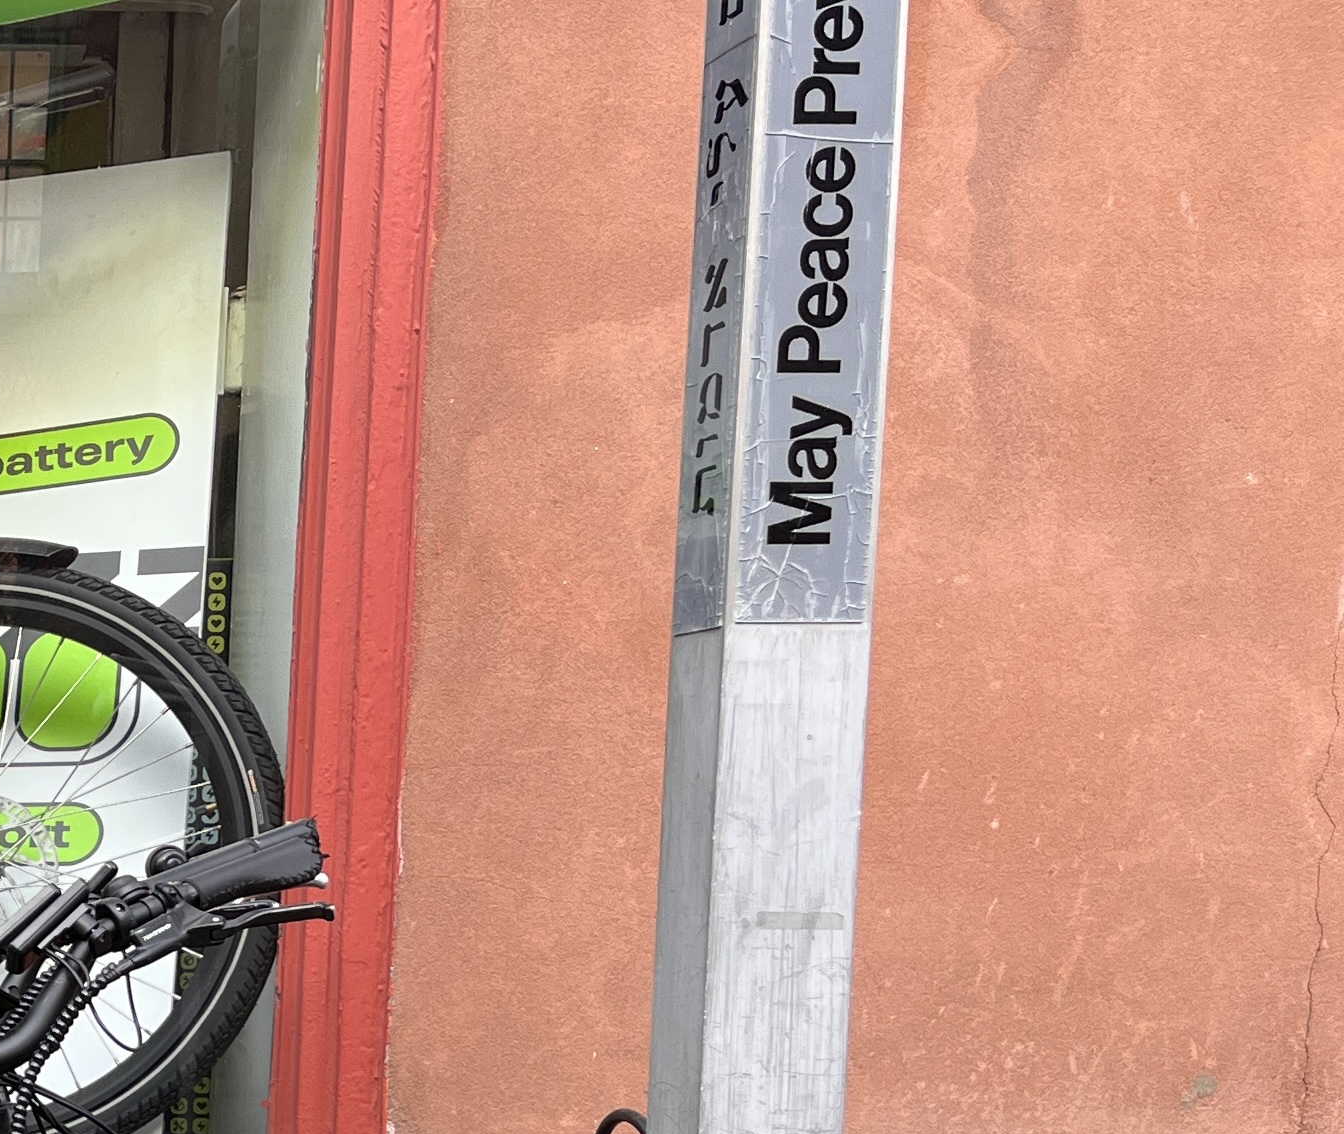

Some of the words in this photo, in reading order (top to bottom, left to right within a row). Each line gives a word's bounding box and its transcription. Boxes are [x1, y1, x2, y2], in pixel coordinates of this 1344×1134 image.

[792, 0, 864, 126] Pre
[777, 146, 857, 374] Peace
[766, 396, 854, 545] May
